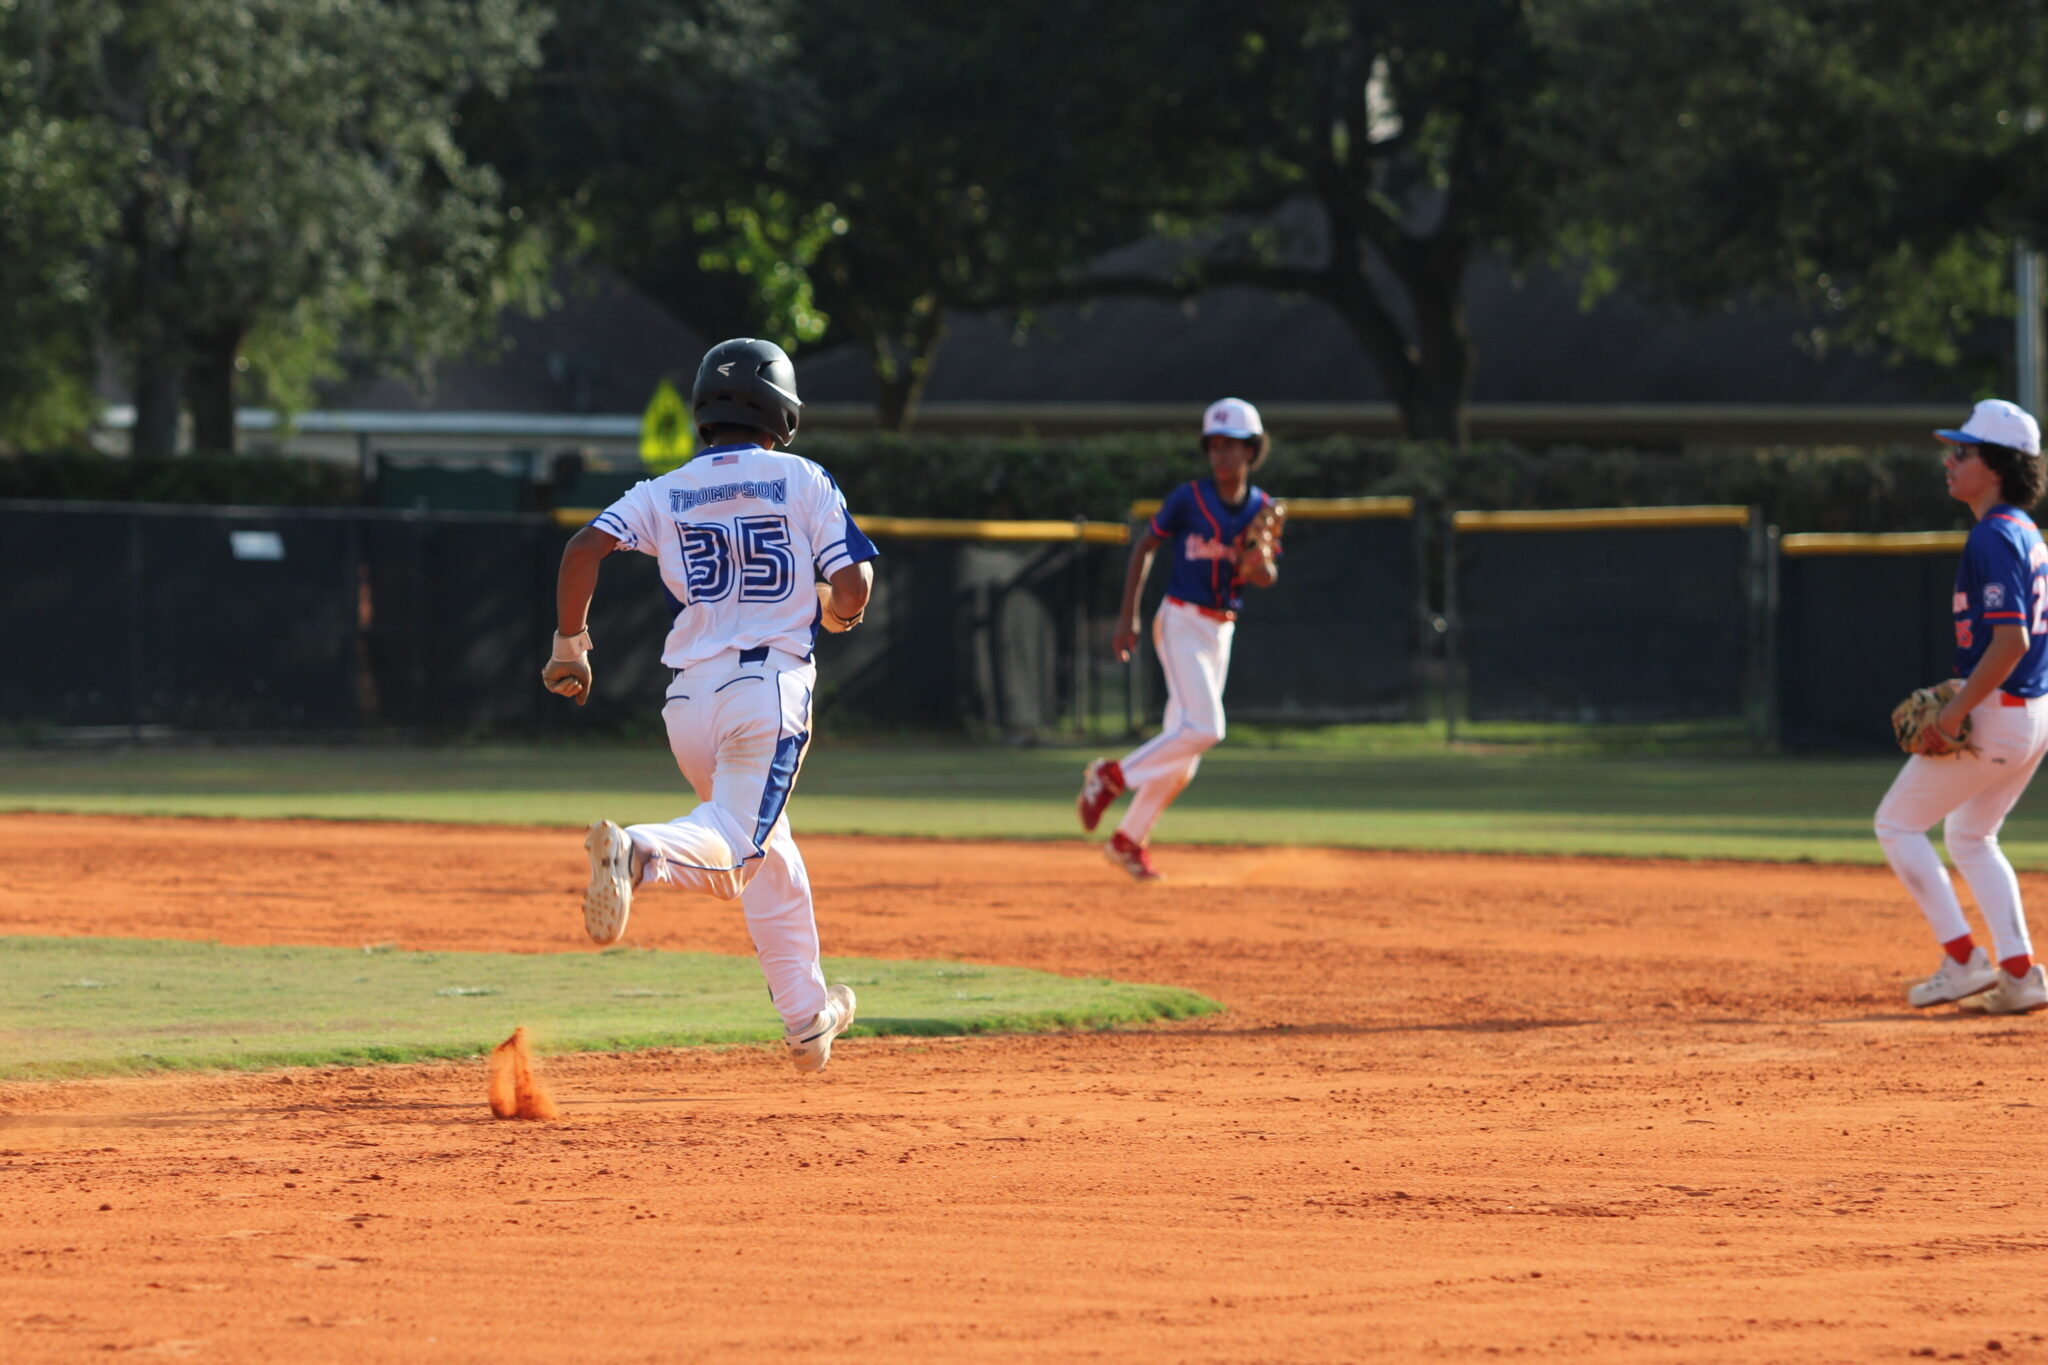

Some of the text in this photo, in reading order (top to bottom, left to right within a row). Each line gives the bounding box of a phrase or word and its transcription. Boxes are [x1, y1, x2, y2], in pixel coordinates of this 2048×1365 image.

[669, 477, 787, 513] THOMPSON
[675, 514, 795, 606] 35
[2032, 575, 2048, 634] 2
